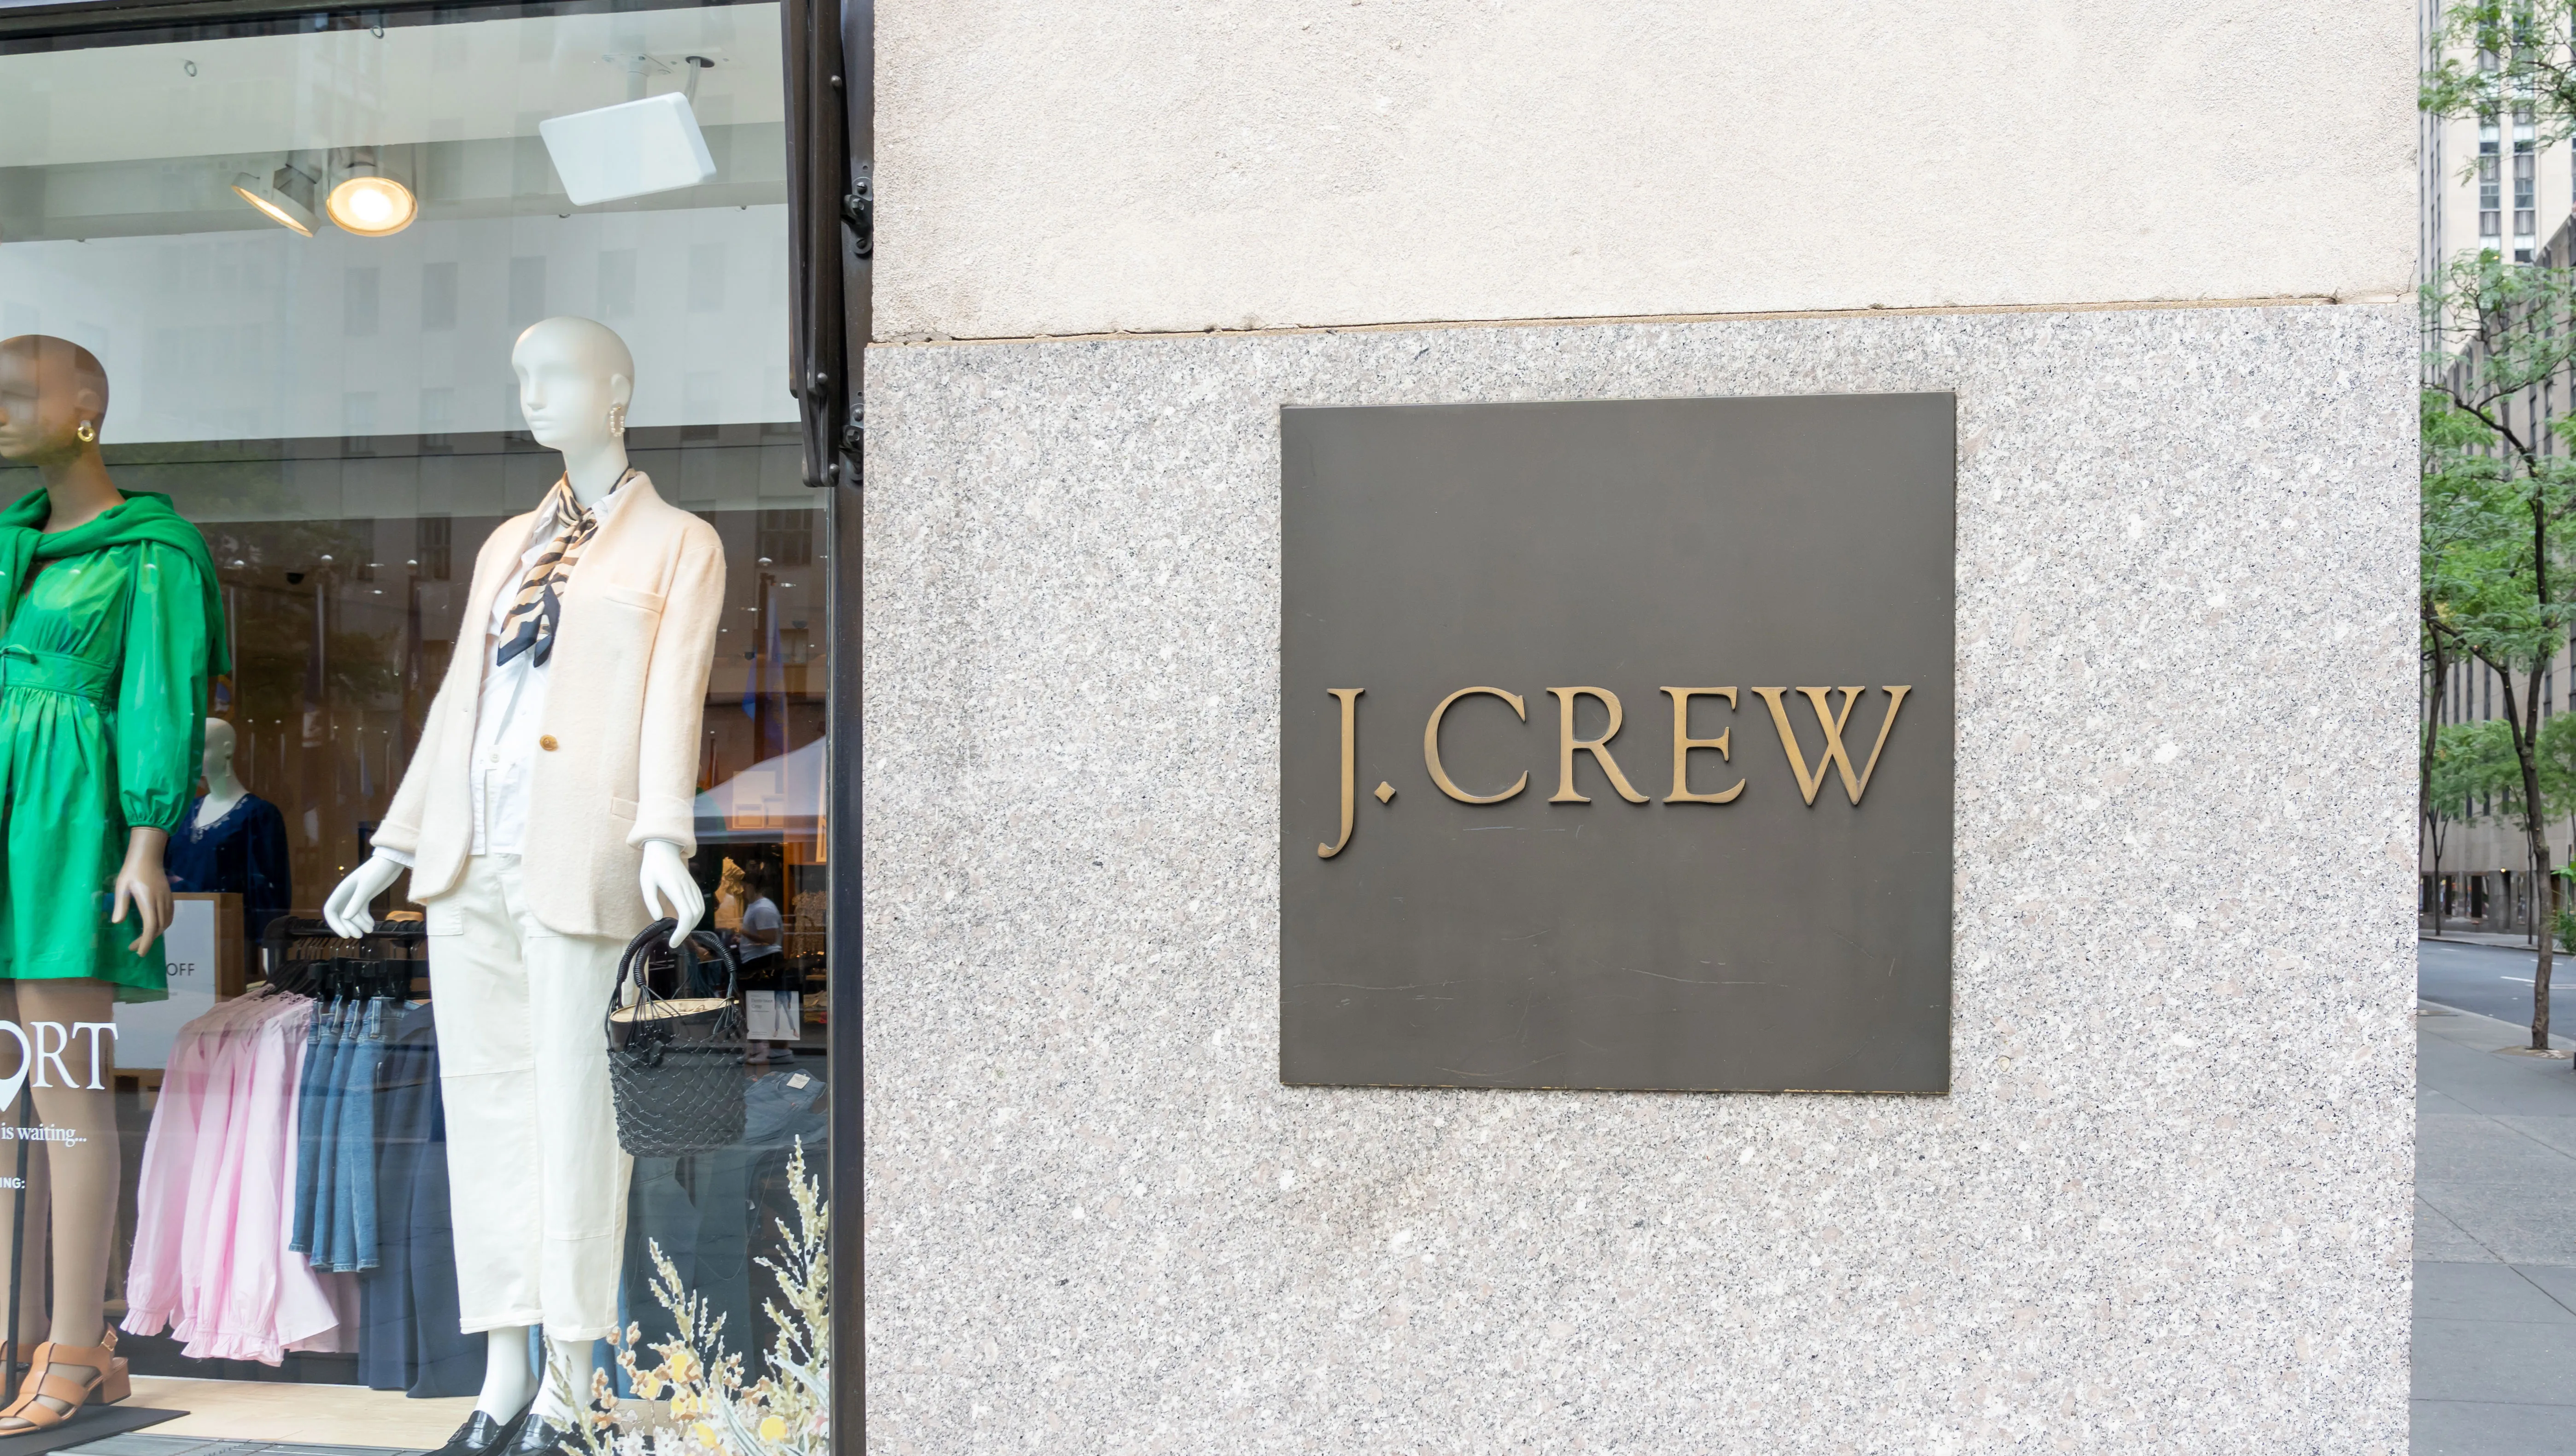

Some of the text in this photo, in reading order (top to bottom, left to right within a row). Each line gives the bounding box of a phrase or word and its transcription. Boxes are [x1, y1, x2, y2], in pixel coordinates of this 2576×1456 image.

[166, 963, 195, 976] OFF
[1, 1122, 87, 1147] is waiting...
